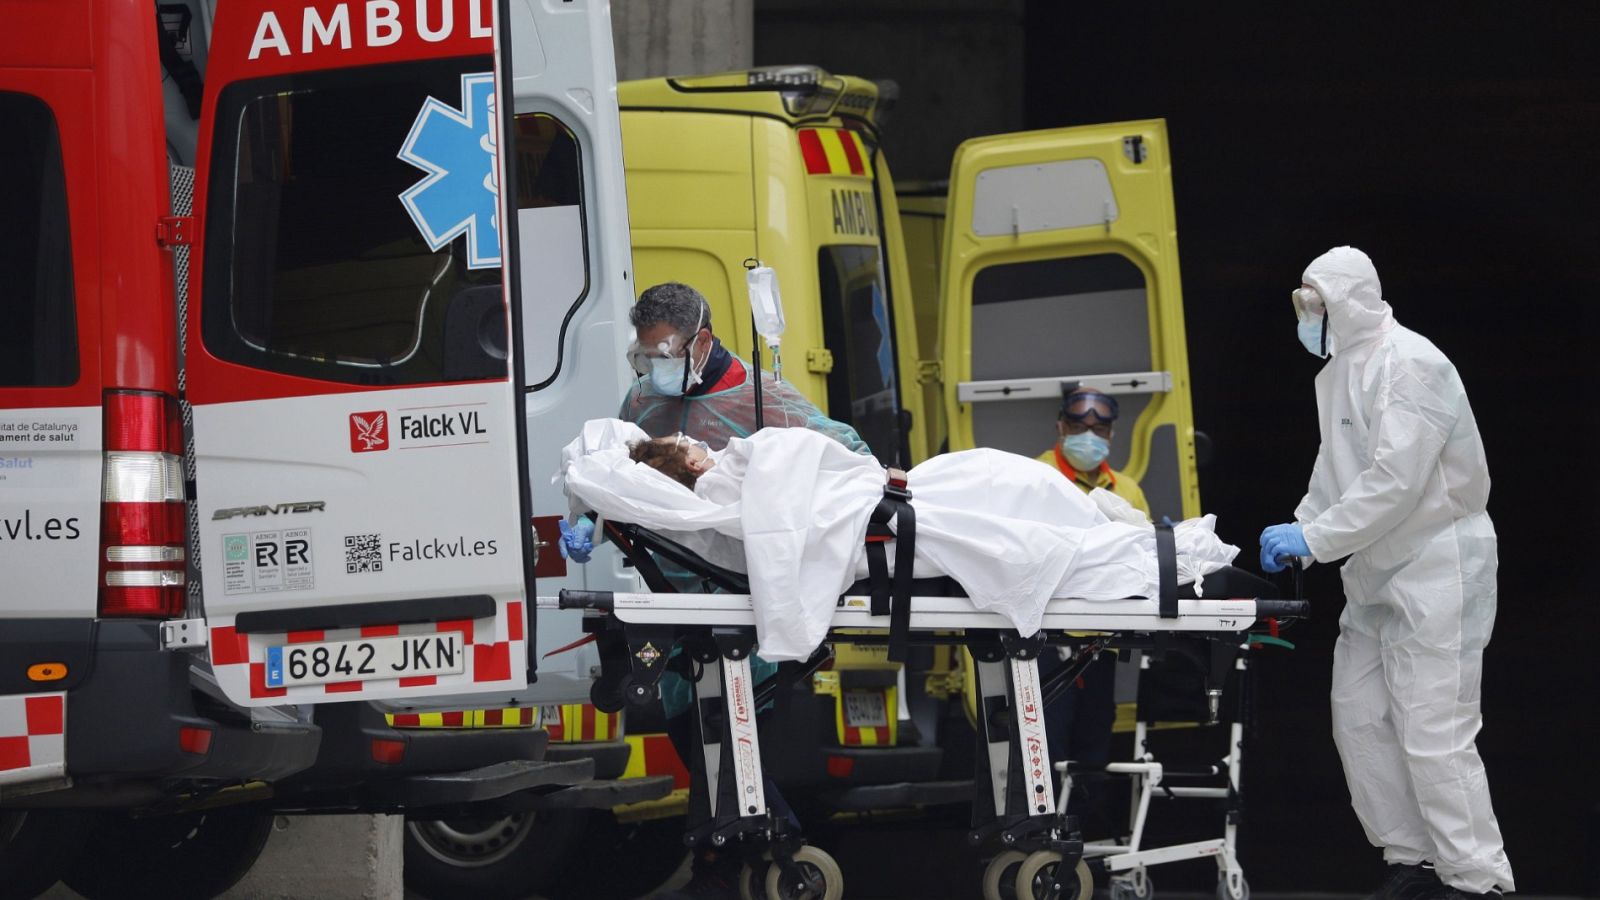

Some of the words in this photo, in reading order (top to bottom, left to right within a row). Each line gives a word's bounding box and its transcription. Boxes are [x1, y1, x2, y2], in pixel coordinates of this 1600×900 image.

[248, 0, 492, 60] AMBUL
[17, 423, 30, 432] de
[31, 422, 78, 433] Catalunya
[400, 409, 455, 440] Falck
[459, 411, 487, 435] VL
[33, 433, 46, 442] de
[48, 433, 75, 442] salut
[211, 500, 327, 520] SPRINTER
[389, 536, 498, 562] Falckvl.es
[289, 643, 376, 680] 6842
[391, 636, 455, 672] JKN
[271, 670, 279, 680] E
